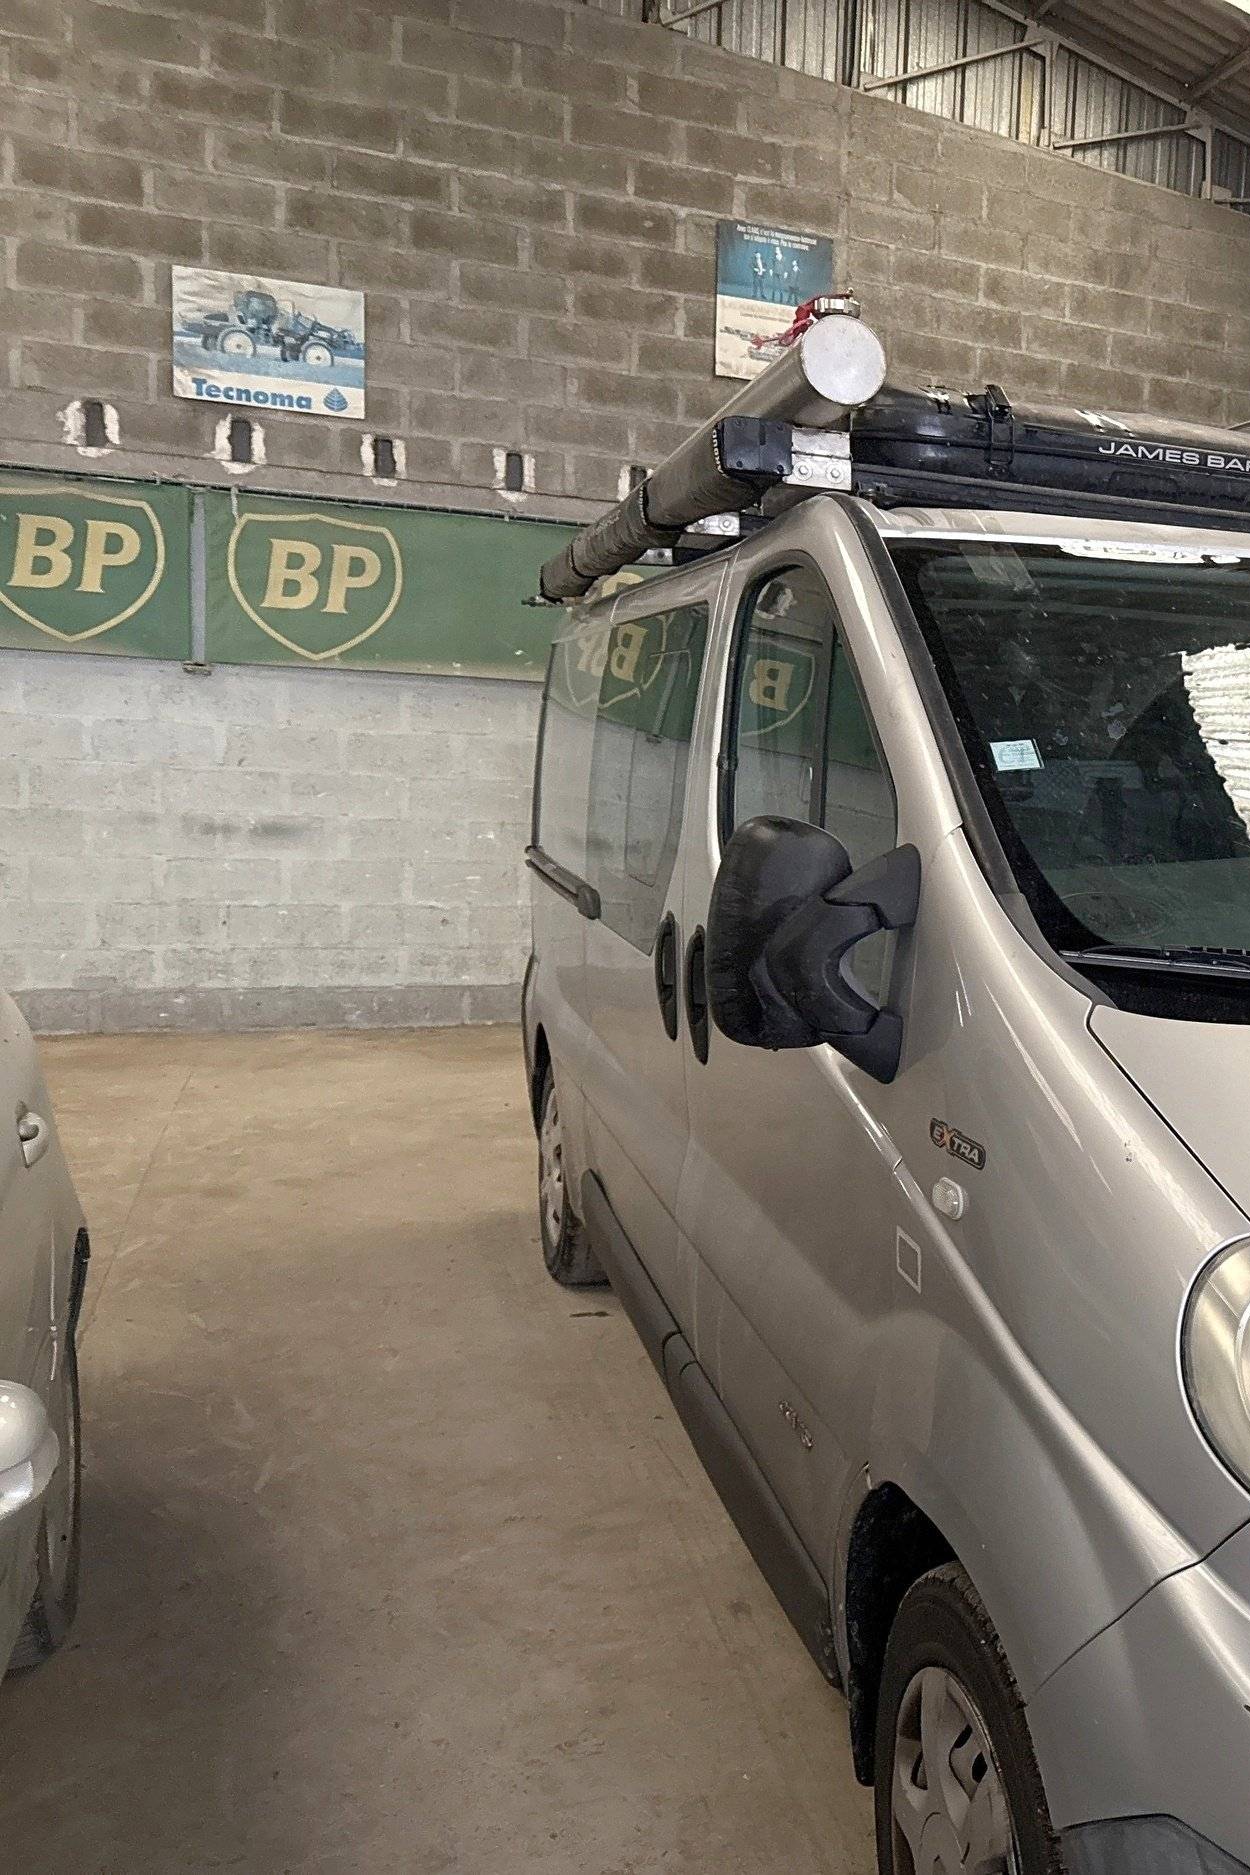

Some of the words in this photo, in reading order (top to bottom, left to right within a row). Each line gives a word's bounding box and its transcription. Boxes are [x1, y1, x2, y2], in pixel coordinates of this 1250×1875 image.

[192, 377, 312, 410] Tecnoma
[1098, 442, 1200, 466] JAMES
[7, 513, 141, 594] BP
[259, 538, 381, 615] BP
[933, 1124, 980, 1163] EXTRA
